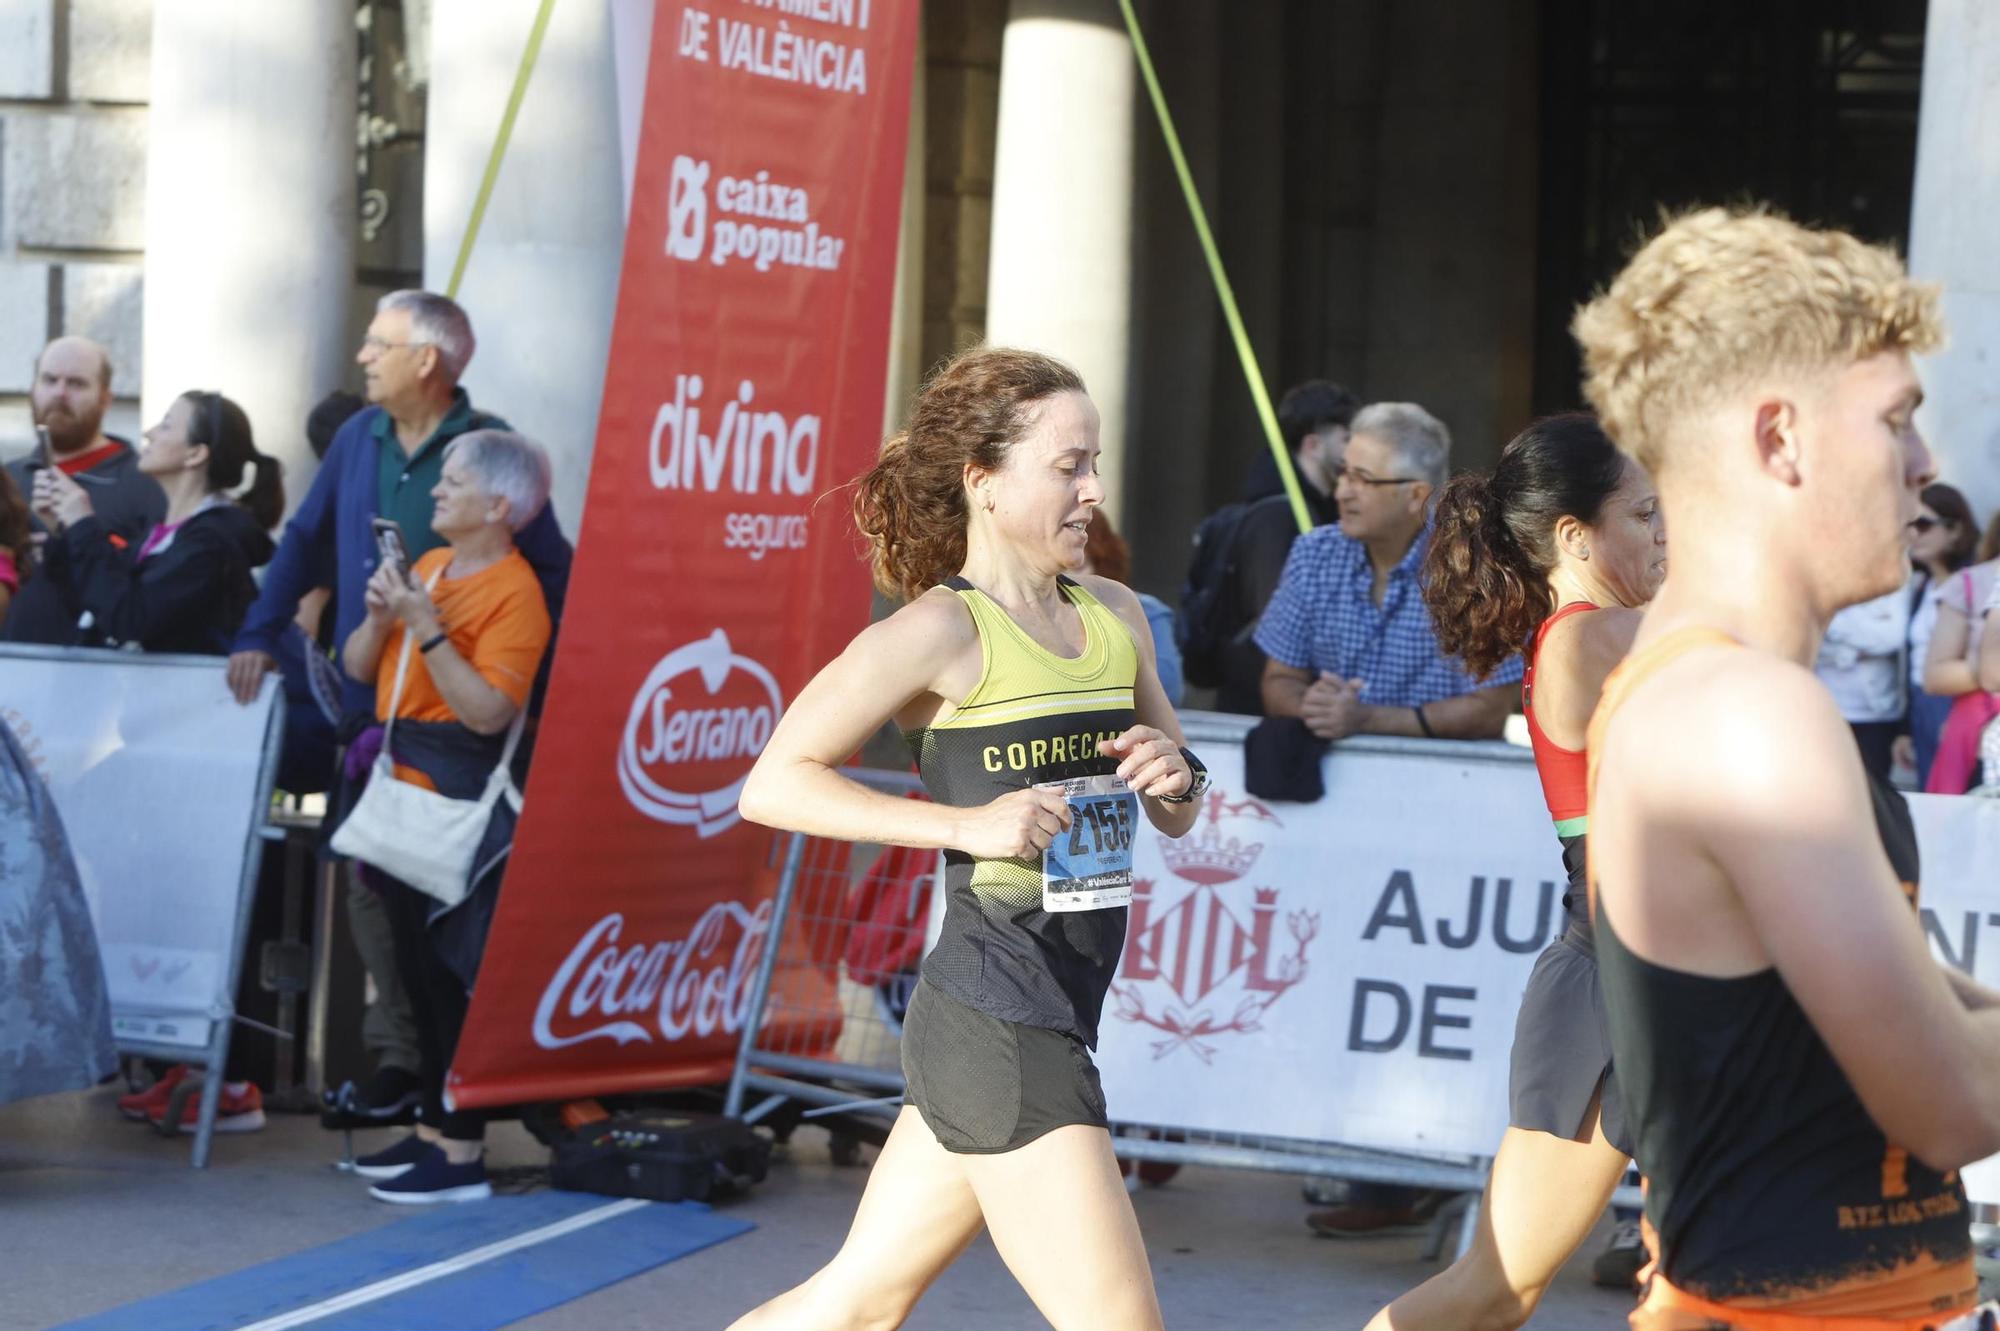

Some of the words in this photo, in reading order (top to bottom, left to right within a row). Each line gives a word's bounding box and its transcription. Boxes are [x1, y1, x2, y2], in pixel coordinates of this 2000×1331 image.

[678, 7, 710, 61] DE
[717, 18, 867, 94] VALÈNCIA
[716, 170, 809, 223] caixa
[649, 374, 820, 496] divina
[724, 512, 808, 560] seguro
[640, 686, 771, 764] Serrano
[1361, 868, 1568, 954] AJU
[1346, 978, 1478, 1061] DE
